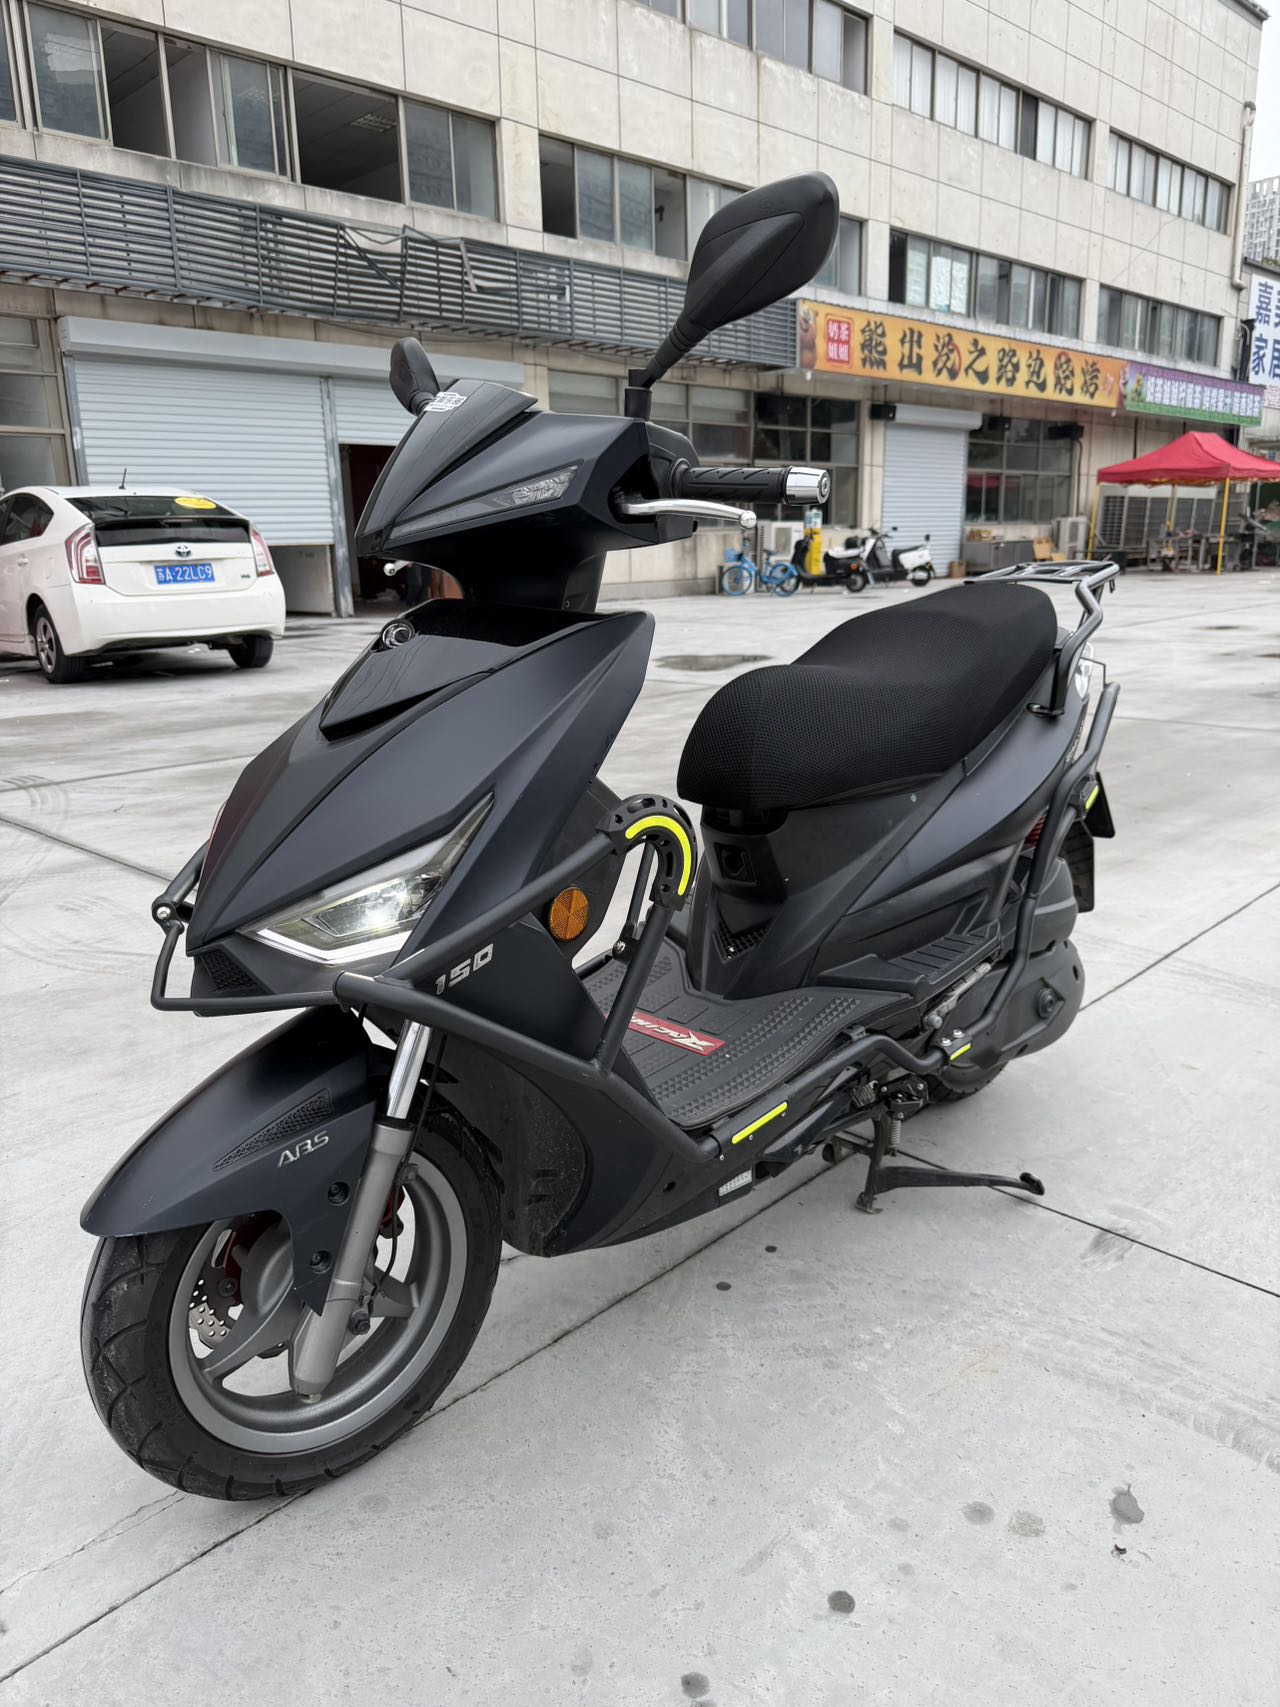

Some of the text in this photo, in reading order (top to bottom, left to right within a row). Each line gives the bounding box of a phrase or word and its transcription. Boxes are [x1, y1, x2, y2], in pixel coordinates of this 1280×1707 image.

[859, 319, 1101, 399] 熊出没之路边烧烤
[434, 943, 494, 995] 150
[276, 1130, 329, 1169] ABS
